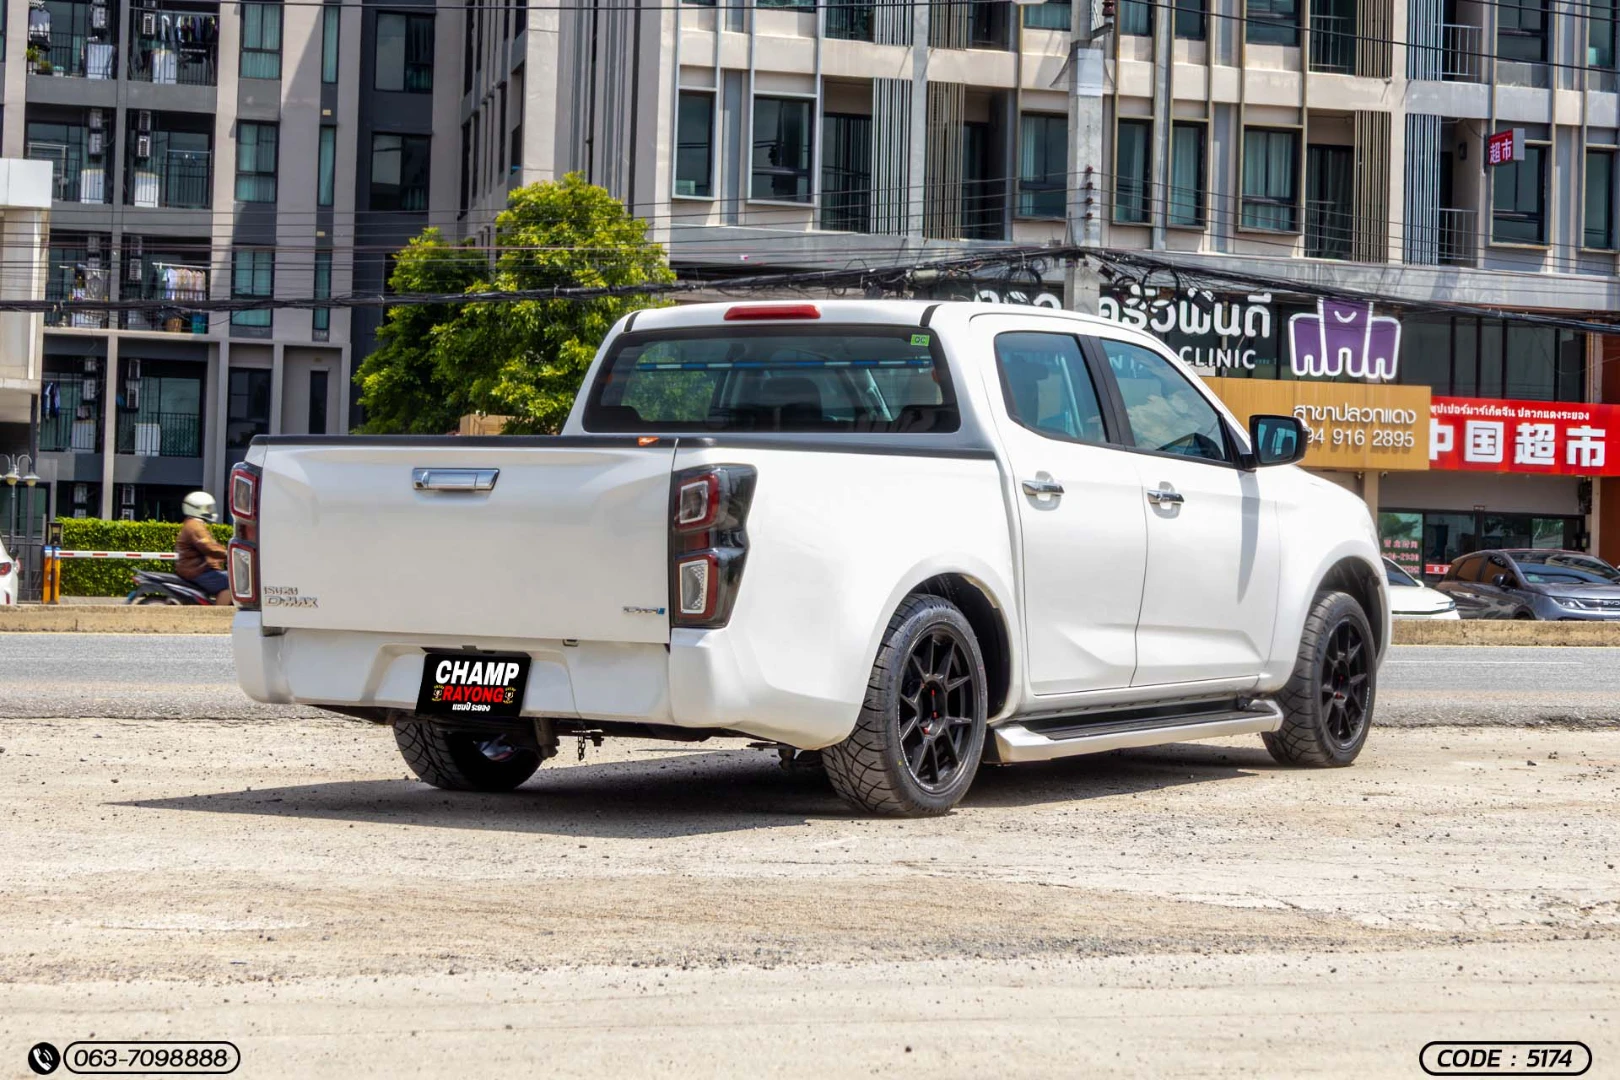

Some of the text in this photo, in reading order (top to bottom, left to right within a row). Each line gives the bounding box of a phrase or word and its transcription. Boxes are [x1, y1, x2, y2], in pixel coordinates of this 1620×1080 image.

[1490, 138, 1513, 164] 超市
[1179, 346, 1256, 369] CLINIC
[1293, 402, 1417, 424] สาขาปลวกแดง
[1307, 428, 1415, 447] 94 916 2895
[435, 660, 520, 685] CHAMP
[442, 686, 505, 702] RAYONG
